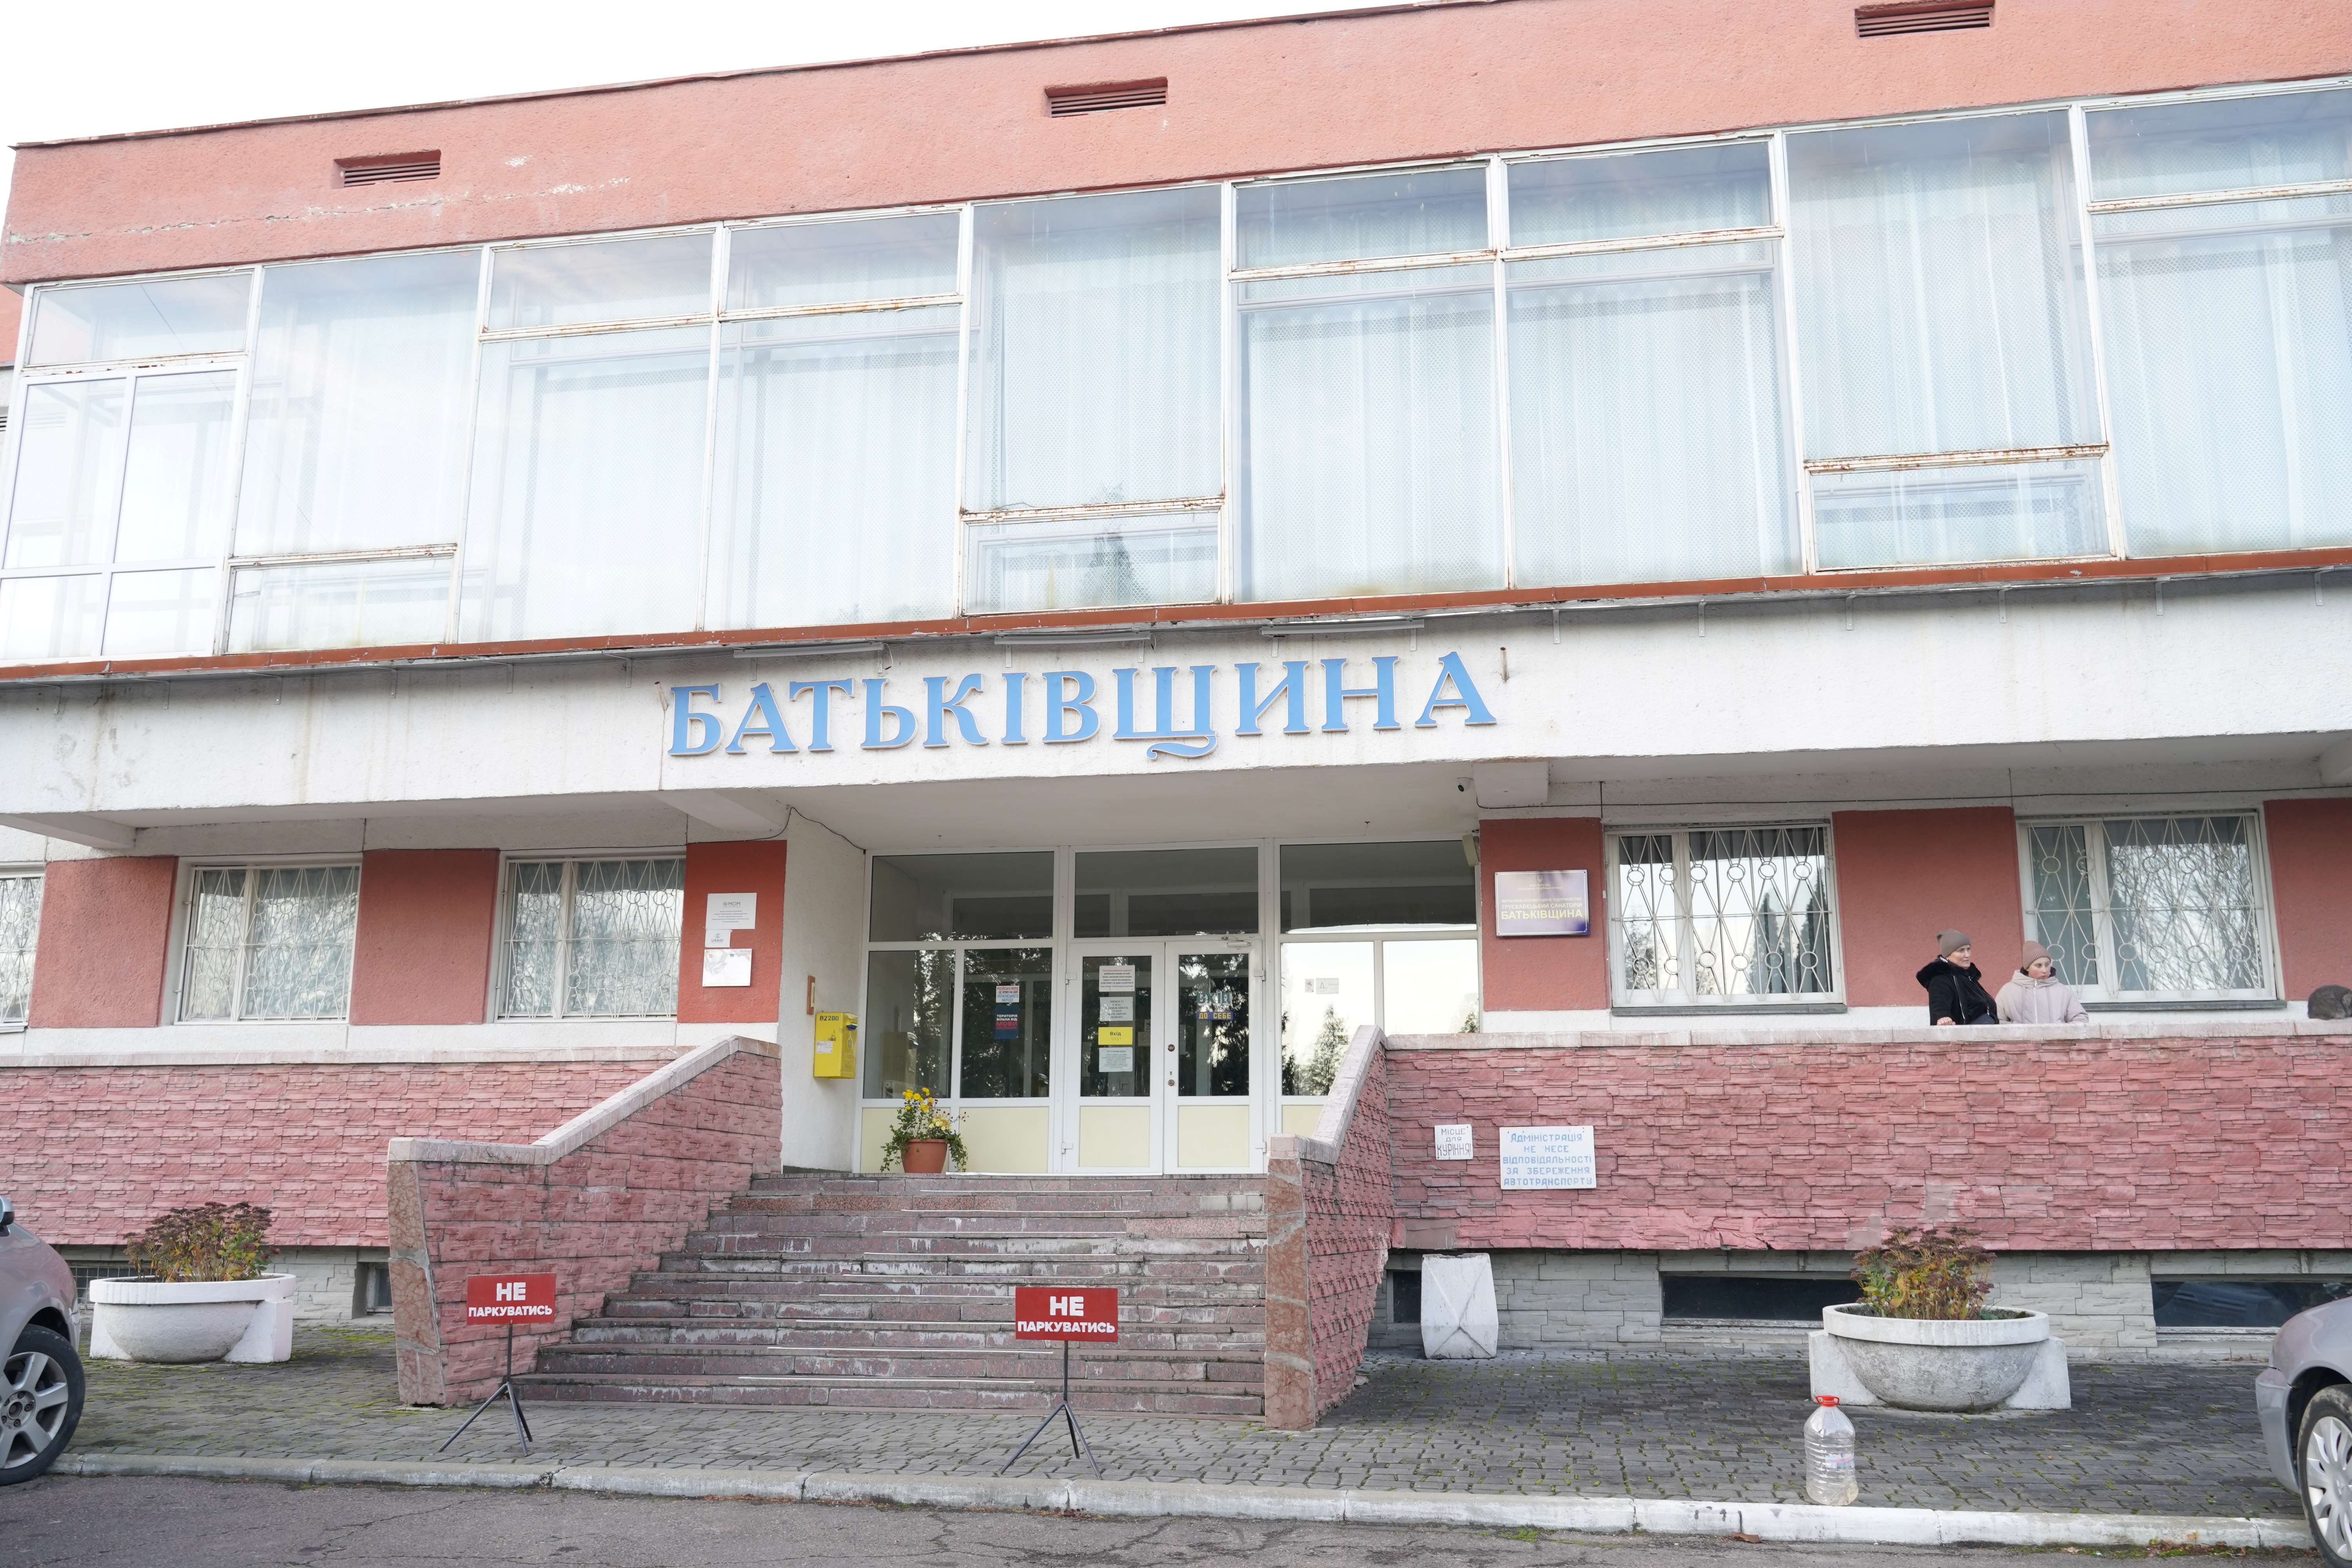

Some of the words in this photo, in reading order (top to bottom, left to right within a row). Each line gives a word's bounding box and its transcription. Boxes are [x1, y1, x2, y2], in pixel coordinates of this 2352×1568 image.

[668, 652, 1496, 760] БАТЬКІВЩИНА
[1501, 909, 1583, 920] БАТЬКІВЩИНА
[1437, 1143, 1472, 1157] КУРІННЯ!
[1504, 1177, 1592, 1186] АВТОТРАНСПОРТУ
[496, 1282, 526, 1301] НЕ
[468, 1305, 552, 1317] ПАРКУВАТИСЬ
[1050, 1296, 1084, 1316] НЕ
[1018, 1321, 1115, 1333] ПАРКУВАТИСЬ
